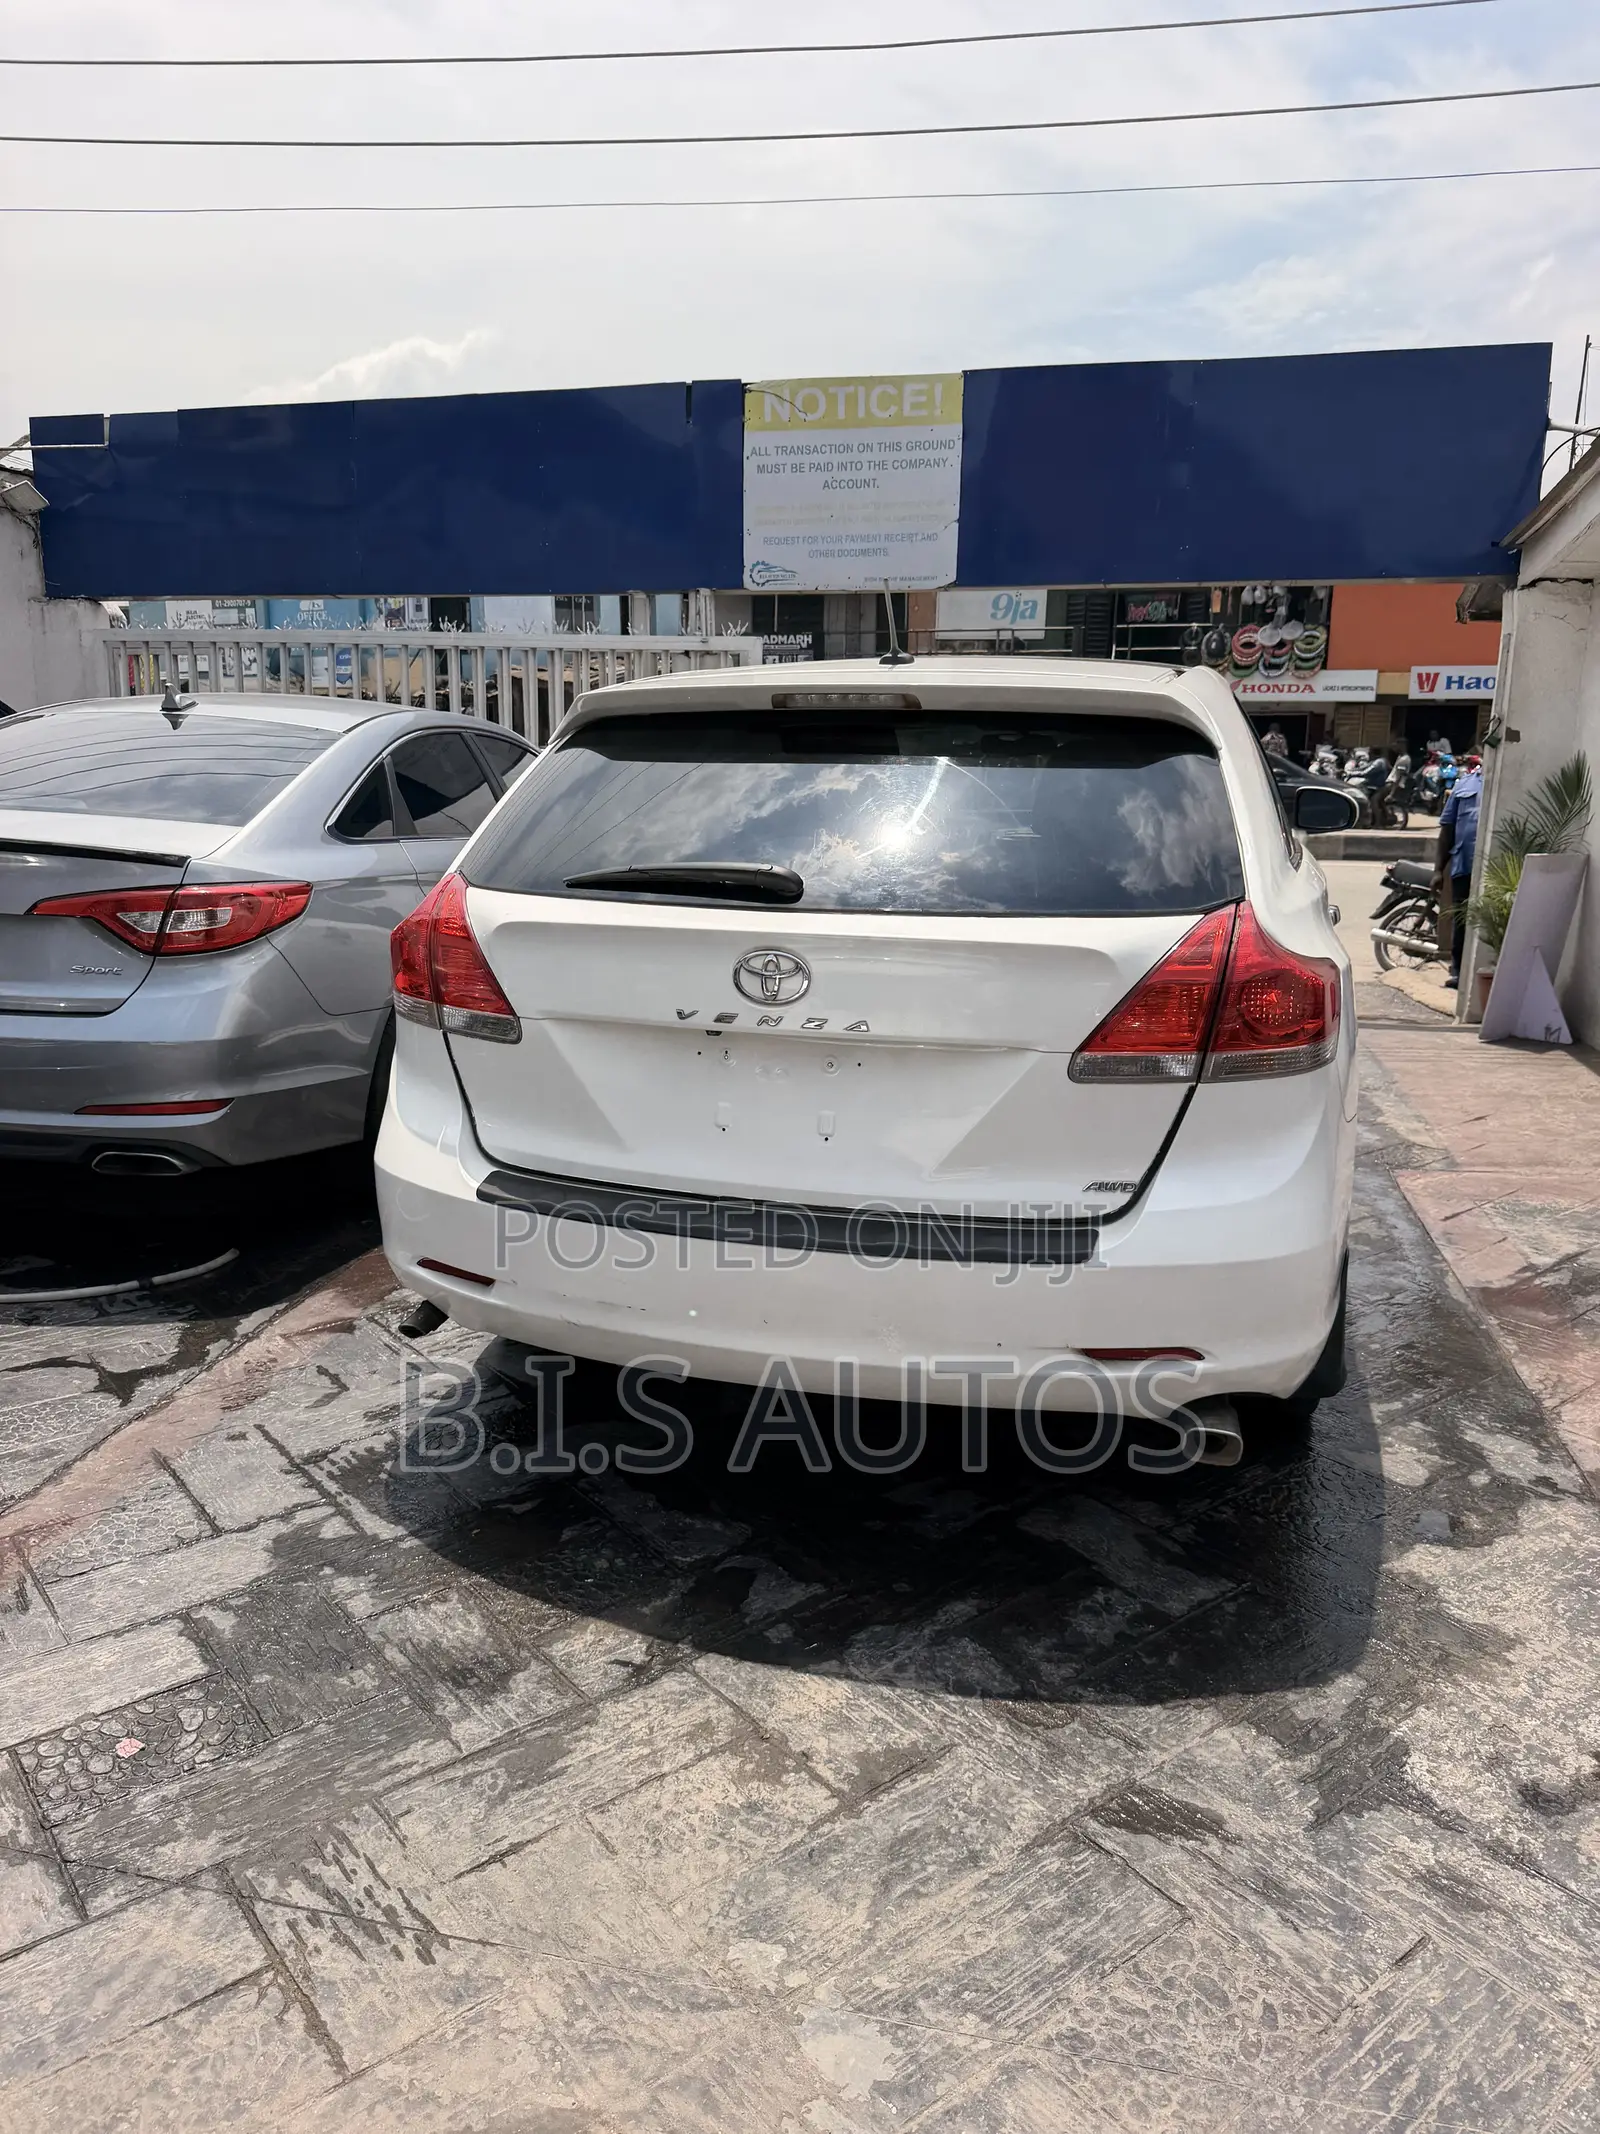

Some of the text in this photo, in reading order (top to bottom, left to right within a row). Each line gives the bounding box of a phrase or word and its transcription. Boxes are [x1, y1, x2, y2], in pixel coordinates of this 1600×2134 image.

[763, 382, 944, 423] NOTICE!
[750, 439, 955, 457] ALL TRANSACTION ON THIS GROUND
[757, 457, 948, 474] MUST BE PAID INTO THE COMPANY
[822, 478, 880, 490] ACCOUNT.
[763, 536, 800, 546] REQUEST
[802, 535, 818, 545] FOR
[820, 534, 843, 545] YOUR
[845, 533, 881, 544] PAYMENT
[920, 532, 939, 542] AND
[808, 549, 835, 559] OTHER
[990, 591, 1038, 625] 9ja
[1241, 683, 1316, 694] HONDA
[69, 964, 123, 976] Sport
[676, 1008, 871, 1033] VENZA
[1082, 1180, 1137, 1193] AWD
